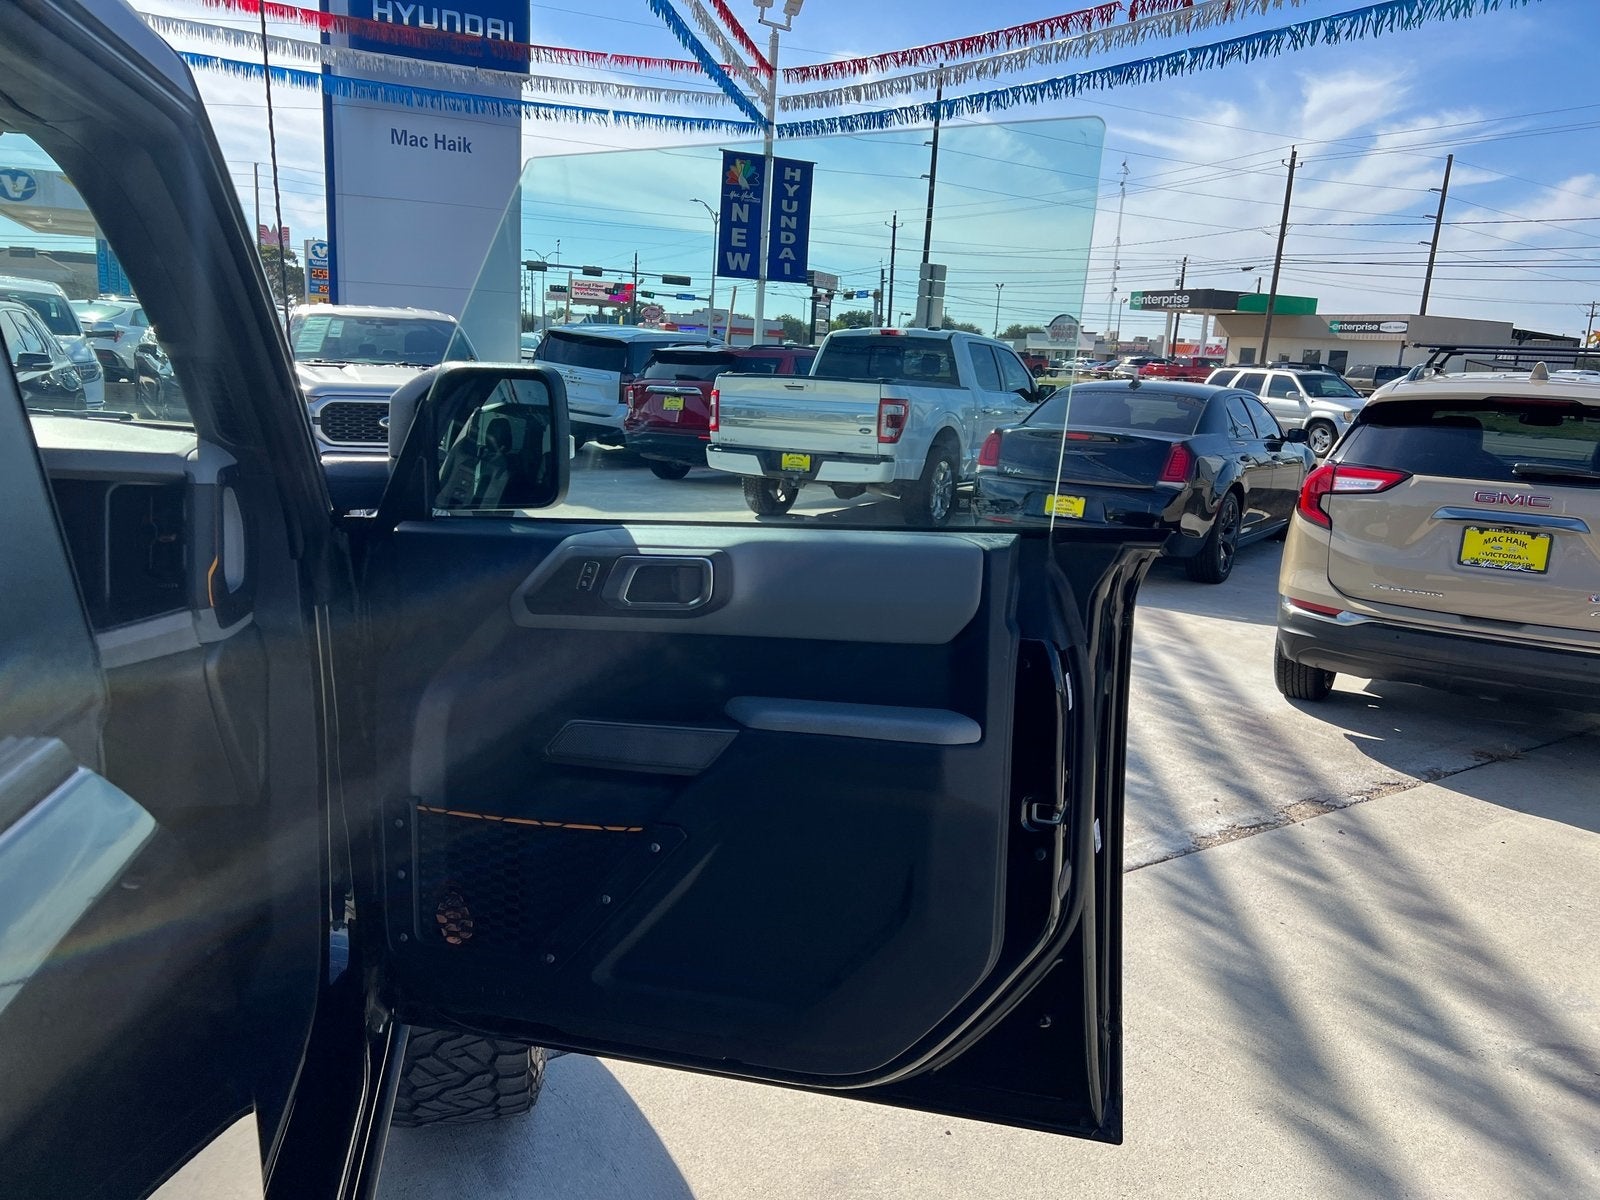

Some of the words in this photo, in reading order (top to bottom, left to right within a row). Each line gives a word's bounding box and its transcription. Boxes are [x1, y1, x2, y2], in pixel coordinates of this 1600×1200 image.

[372, 0, 514, 42] HYUNDAI
[390, 127, 429, 149] Mac
[434, 132, 473, 153] Haik
[778, 166, 802, 275] HYUNDAI
[726, 202, 751, 272] NEW
[1130, 292, 1190, 307] enterprise
[1329, 322, 1379, 332] enterprise
[1473, 491, 1552, 508] GMC
[1483, 535, 1504, 546] MAC
[1505, 536, 1528, 549] HAIK
[1482, 551, 1522, 560] VICTORIA
